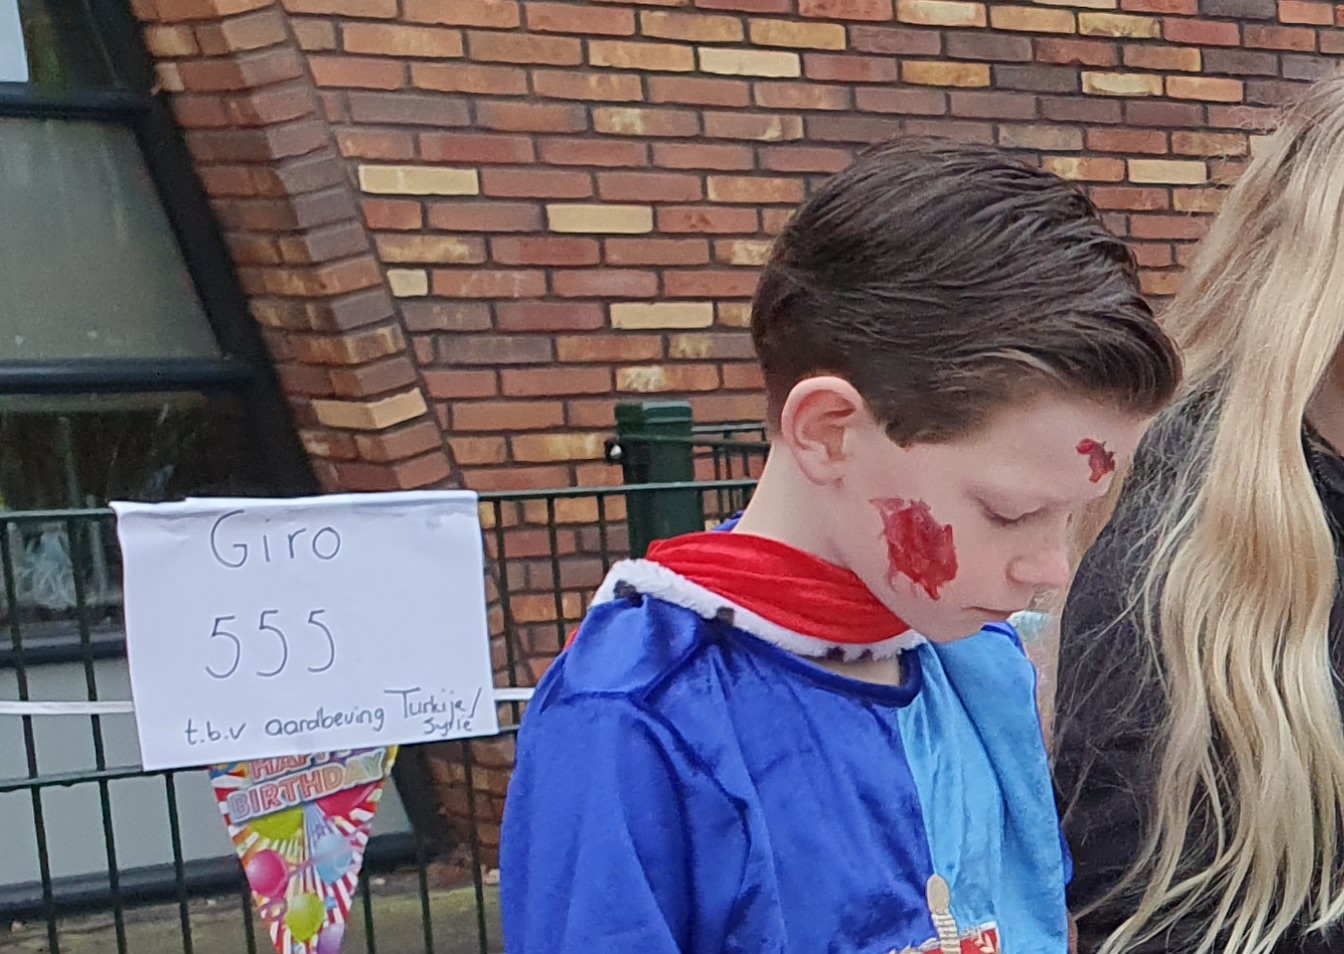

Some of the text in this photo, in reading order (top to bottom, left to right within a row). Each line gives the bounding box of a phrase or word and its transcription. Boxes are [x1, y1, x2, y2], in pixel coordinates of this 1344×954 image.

[210, 509, 341, 568] Giro
[205, 609, 336, 679] 555
[265, 706, 385, 737] aardbeving
[229, 750, 385, 821] BIRTHDAY
